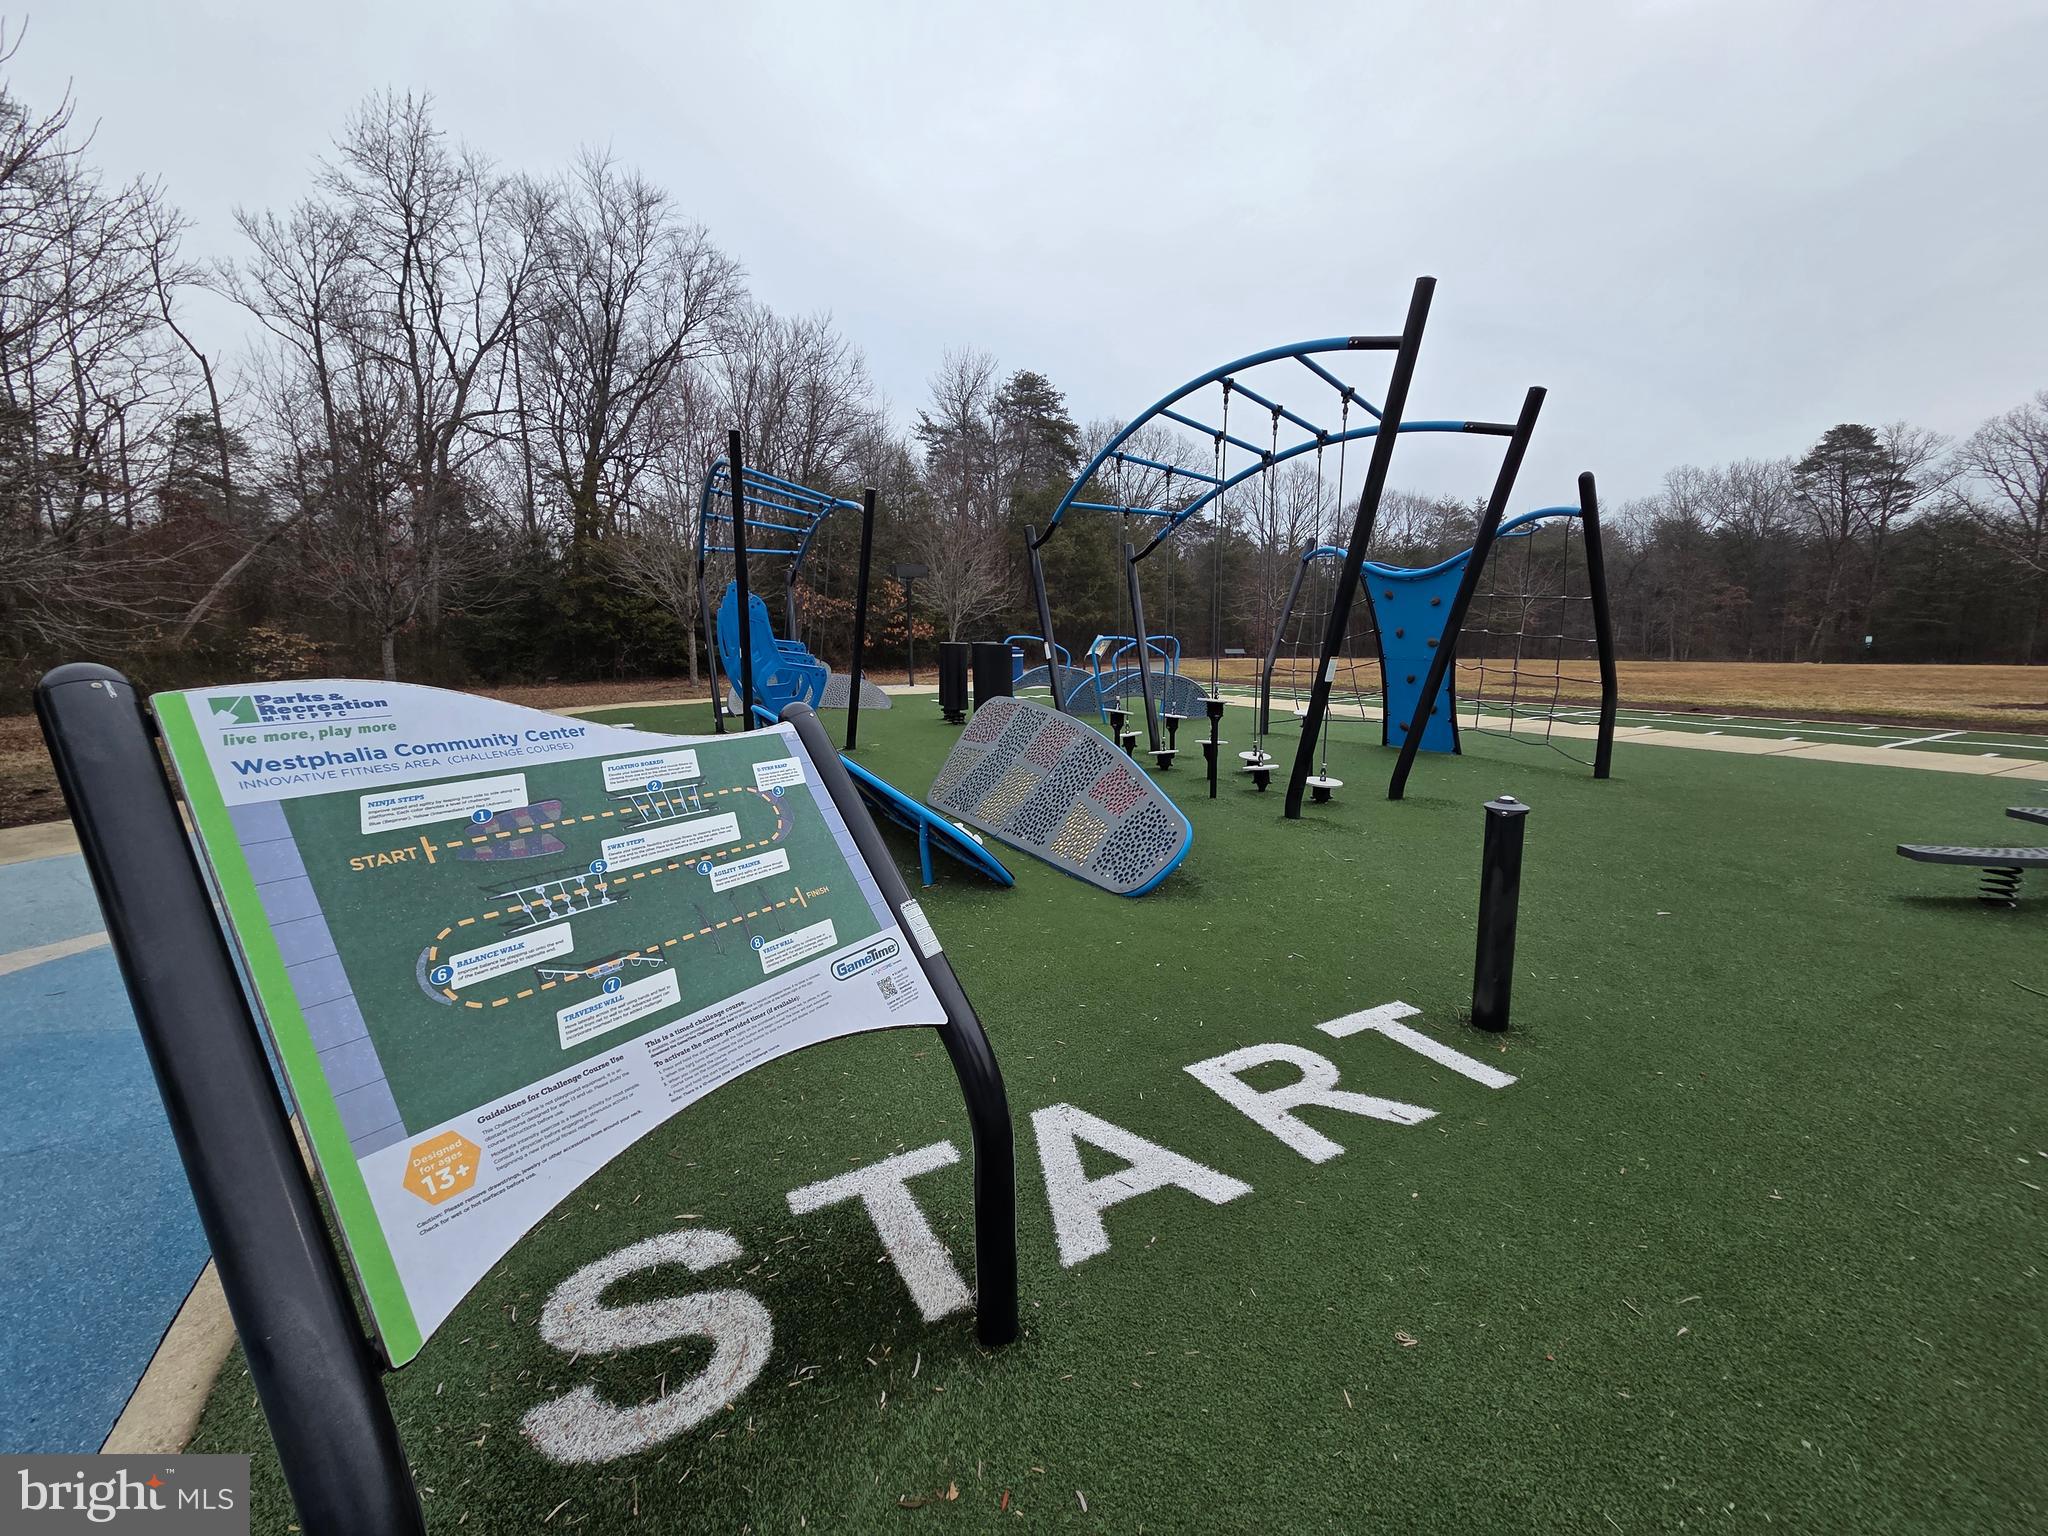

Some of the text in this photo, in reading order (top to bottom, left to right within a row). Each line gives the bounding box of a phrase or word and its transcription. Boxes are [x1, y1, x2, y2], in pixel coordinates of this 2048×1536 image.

[254, 693, 325, 705] Parks
[256, 699, 388, 715] Recreation
[223, 723, 396, 746] live more, play more
[231, 727, 585, 775] Westphalia Community Center
[239, 743, 574, 790] INNOVATIVE FITNESS AREA (CHALLENGE COURSE)
[608, 763, 639, 771] FLOATING
[652, 782, 658, 790] 2
[774, 786, 781, 794] 3
[368, 795, 424, 808] NINJA STEPS
[479, 811, 486, 821] 1
[607, 838, 645, 850] SWAY STEPS
[350, 847, 416, 870] START
[592, 862, 602, 871] 5
[699, 863, 708, 872] 4
[714, 867, 736, 877] AGILITY
[806, 886, 829, 898] FINISH
[752, 938, 761, 948] 8
[780, 939, 794, 947] WALL
[457, 942, 525, 968] BALANCE WALK
[479, 960, 498, 968] balance
[837, 945, 895, 976] GameTime
[438, 969, 447, 981] 6
[605, 980, 615, 991] 7
[563, 995, 624, 1022] TRAVERSE WALL
[645, 1038, 661, 1048] This
[674, 1022, 694, 1035] timed
[695, 1010, 724, 1026] challenge
[725, 1001, 744, 1012] course.
[664, 1048, 690, 1063] activate
[703, 1018, 750, 1044] course-provided
[750, 1012, 766, 1022] timer
[774, 996, 799, 1011] available):
[477, 1056, 624, 1124] Guidelines for Challenge Course Use
[485, 1129, 507, 1142] obstacle
[508, 1120, 526, 1131] course
[527, 1108, 550, 1122] designed
[594, 1082, 608, 1090] Please
[609, 1075, 621, 1083] study
[494, 1115, 520, 1129] Challenge
[521, 1107, 539, 1117] Course
[554, 1087, 581, 1102] playground
[488, 1138, 505, 1148] course
[507, 1123, 537, 1139] instructions
[537, 1115, 553, 1125] before
[491, 1143, 516, 1157] Moderate
[517, 1133, 539, 1145] intensity
[540, 1122, 560, 1134] exercise
[569, 1109, 587, 1119] healthy
[588, 1100, 604, 1110] activity
[493, 1152, 514, 1164] Consult
[520, 1138, 544, 1152] physician
[544, 1129, 560, 1139] before
[561, 1118, 584, 1131] engaging
[590, 1104, 612, 1117] strenuous
[613, 1096, 628, 1106] activity
[413, 1139, 462, 1167] Designed
[496, 1155, 524, 1171] beginning
[540, 1136, 560, 1150] physical
[561, 1129, 577, 1138] fitness
[416, 1212, 443, 1228] Caution:
[444, 1202, 464, 1214] Please
[465, 1190, 487, 1203] remove
[488, 1173, 521, 1191] drawstrings,
[522, 1162, 540, 1174] jewelry
[549, 1151, 562, 1160] other
[563, 1136, 590, 1152] accessories
[603, 1121, 619, 1132] around
[420, 1152, 462, 1175] for ages
[421, 1164, 469, 1195] 13+
[419, 1223, 439, 1236] Check
[451, 1211, 462, 1219] wet
[482, 1188, 506, 1203] surfaces
[506, 1178, 525, 1190] before
[519, 1002, 1517, 1464] START
